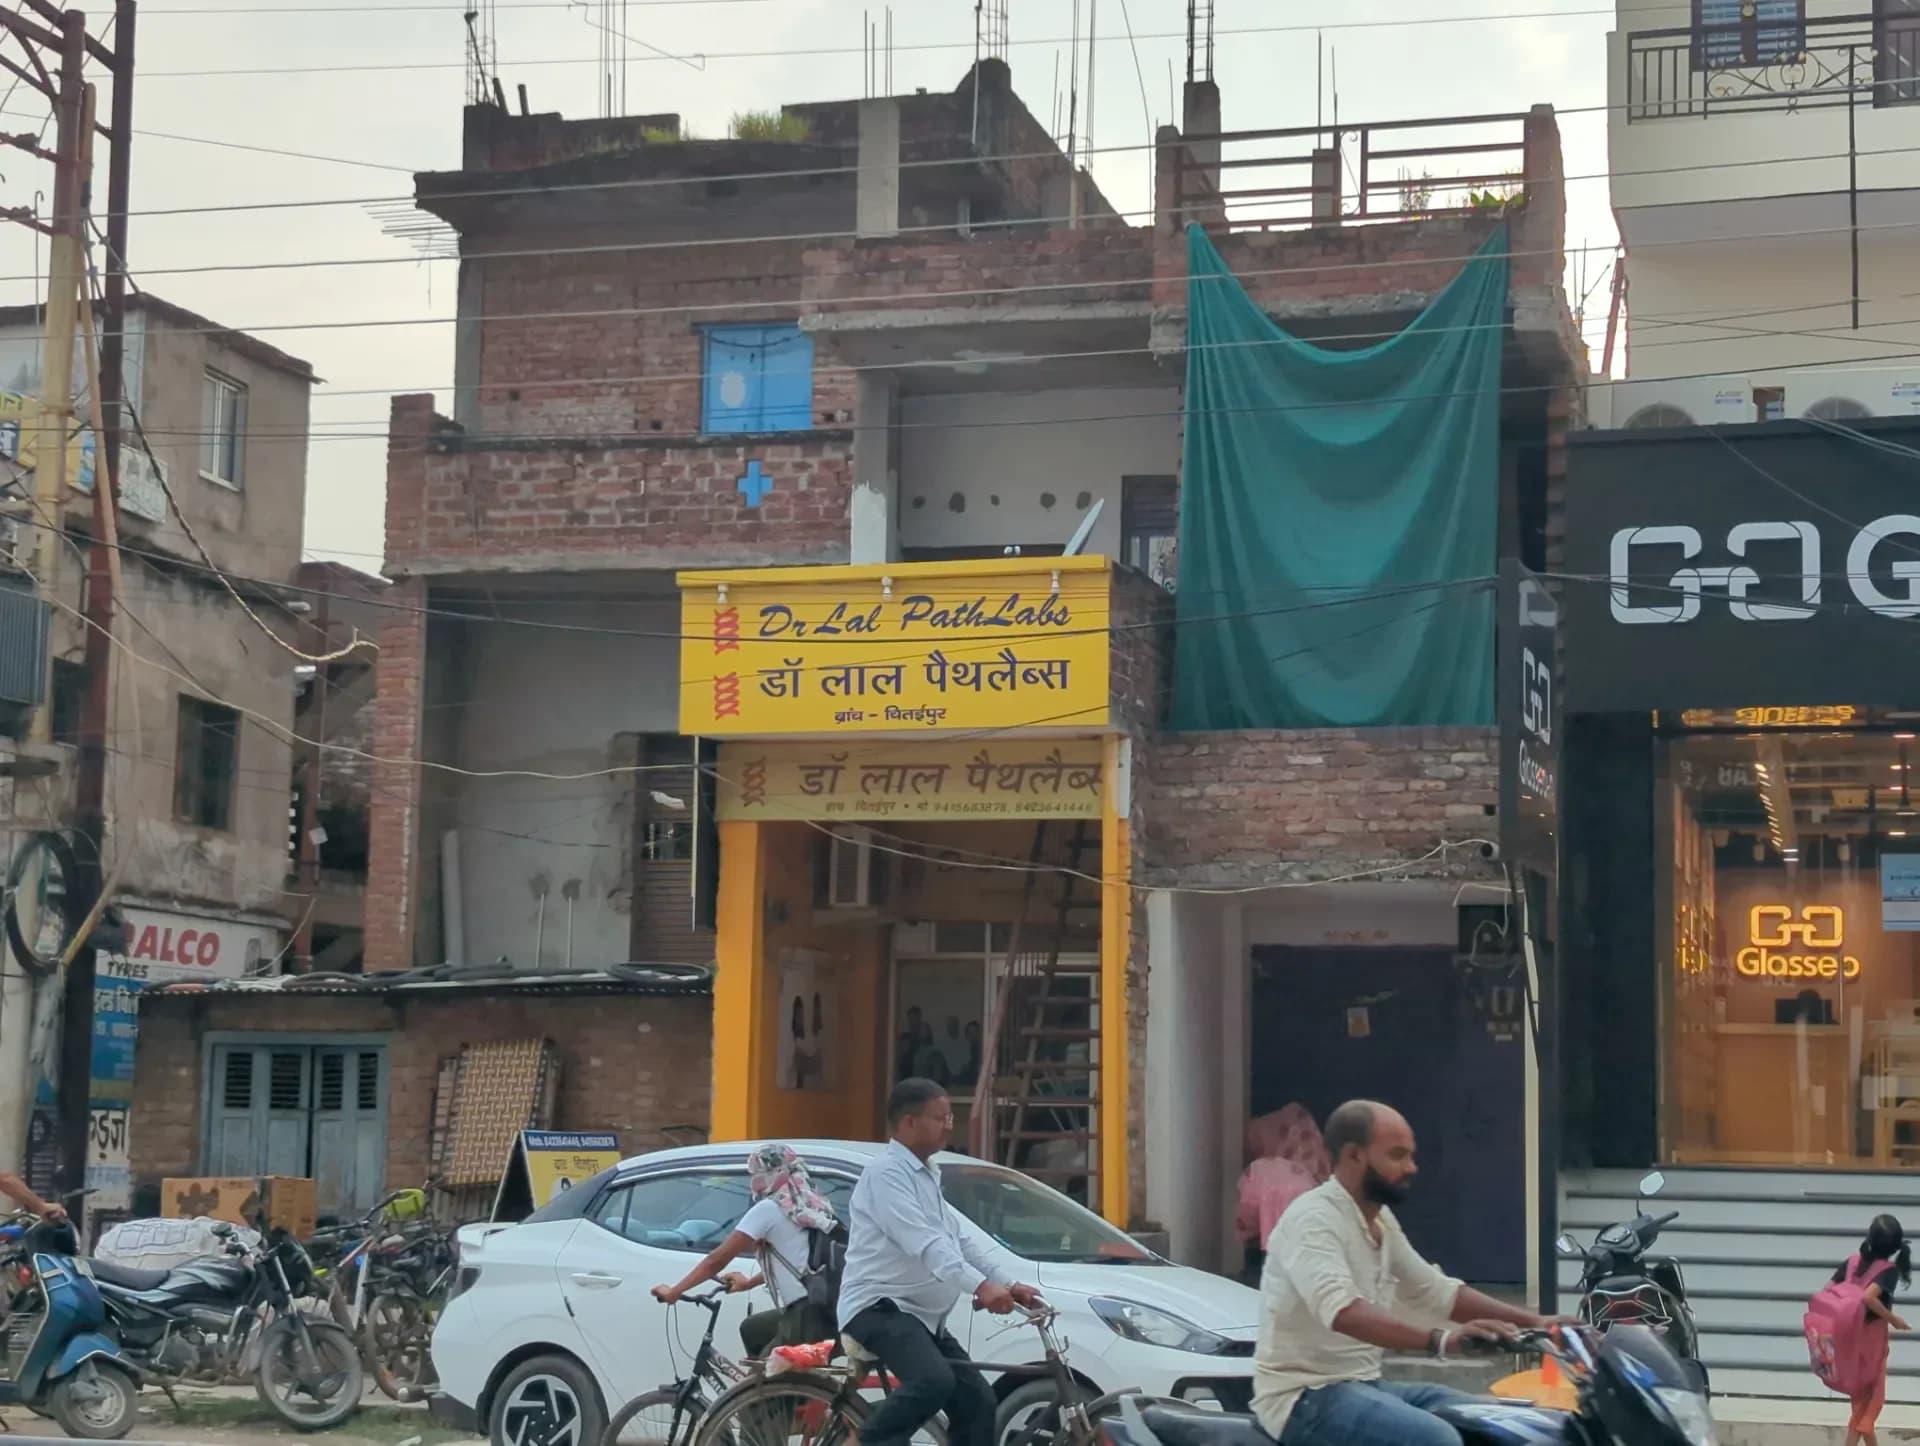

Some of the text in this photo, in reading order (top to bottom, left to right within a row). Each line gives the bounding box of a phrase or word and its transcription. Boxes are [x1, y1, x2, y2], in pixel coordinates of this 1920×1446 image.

[759, 592, 1072, 638] Dr Lal PathLabs
[757, 647, 1072, 699] डॉ लाल पैथलैब्स
[796, 751, 849, 796] डॉ
[859, 763, 952, 796] लाल
[107, 960, 150, 979] TYRES
